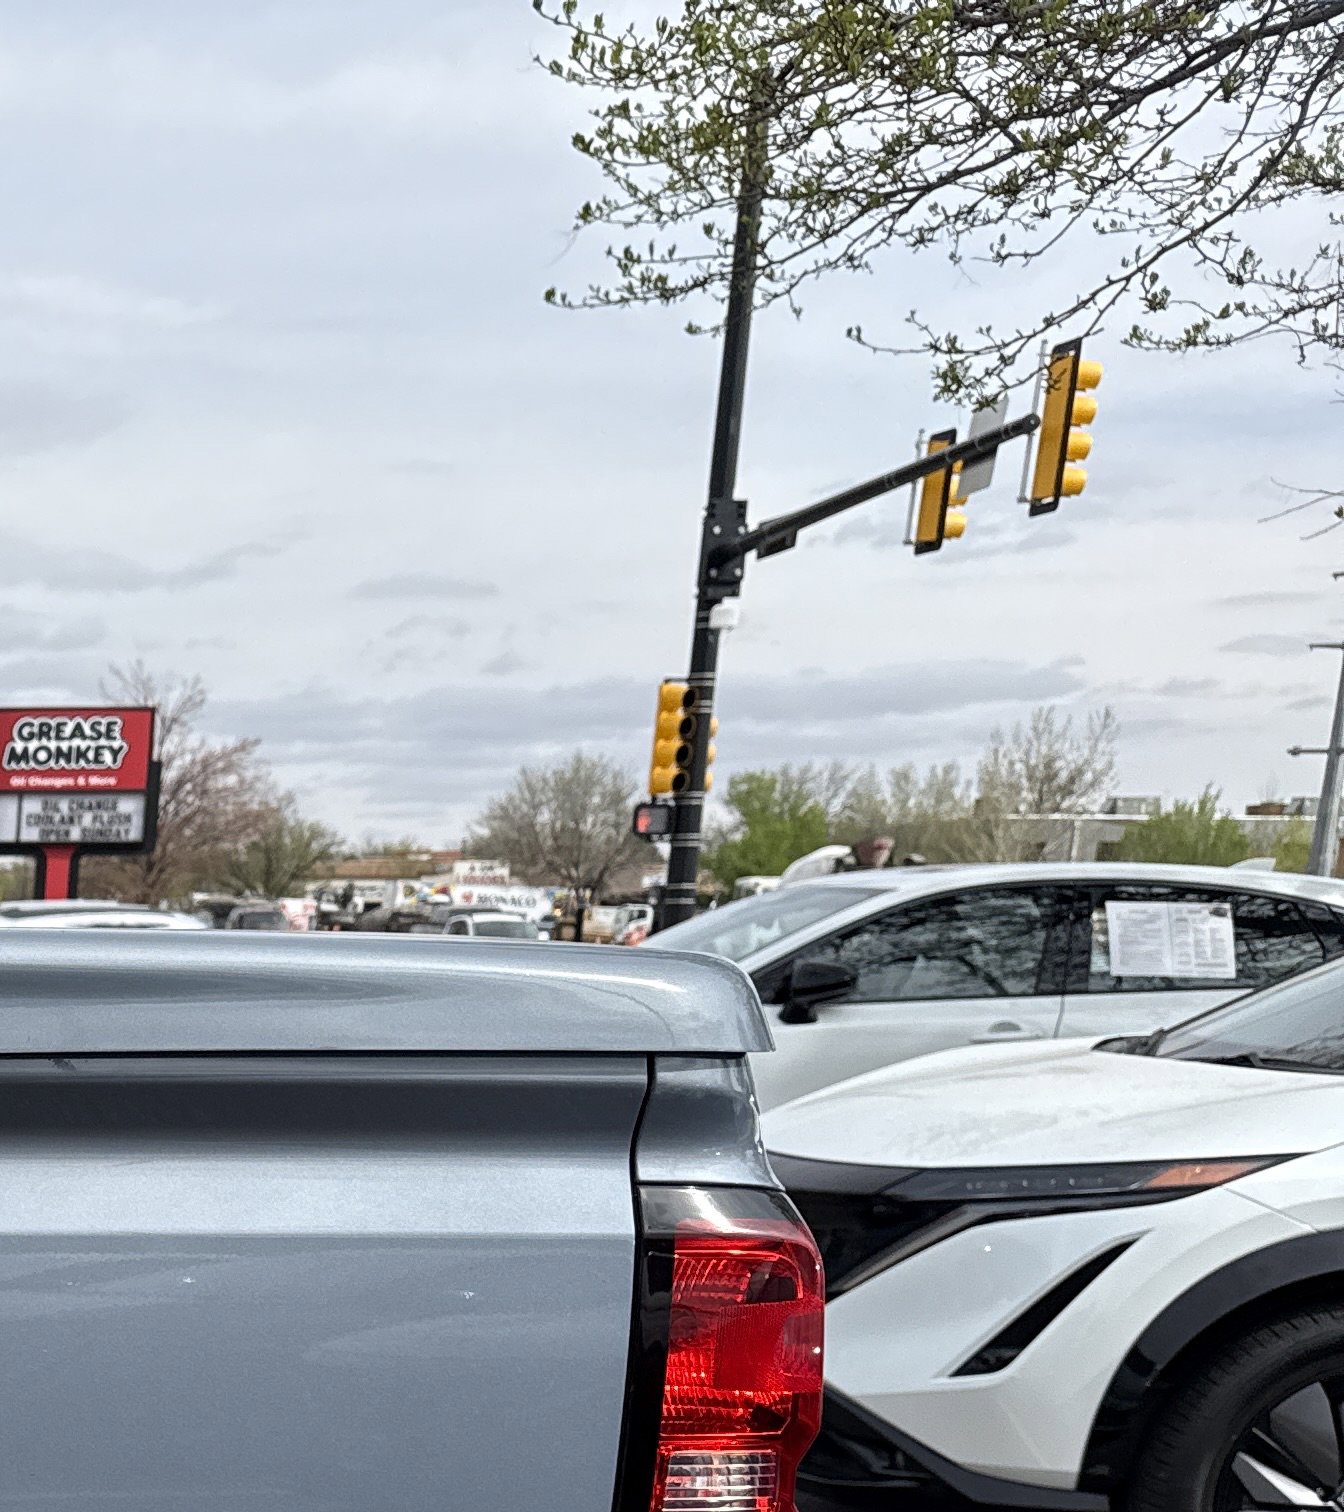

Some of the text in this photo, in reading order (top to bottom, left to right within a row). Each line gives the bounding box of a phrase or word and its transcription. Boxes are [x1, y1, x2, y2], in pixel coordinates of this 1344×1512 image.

[16, 721, 119, 742] GREASE
[6, 745, 125, 767] MONKEY
[41, 799, 60, 812] OIL
[26, 813, 83, 827] COOLANT
